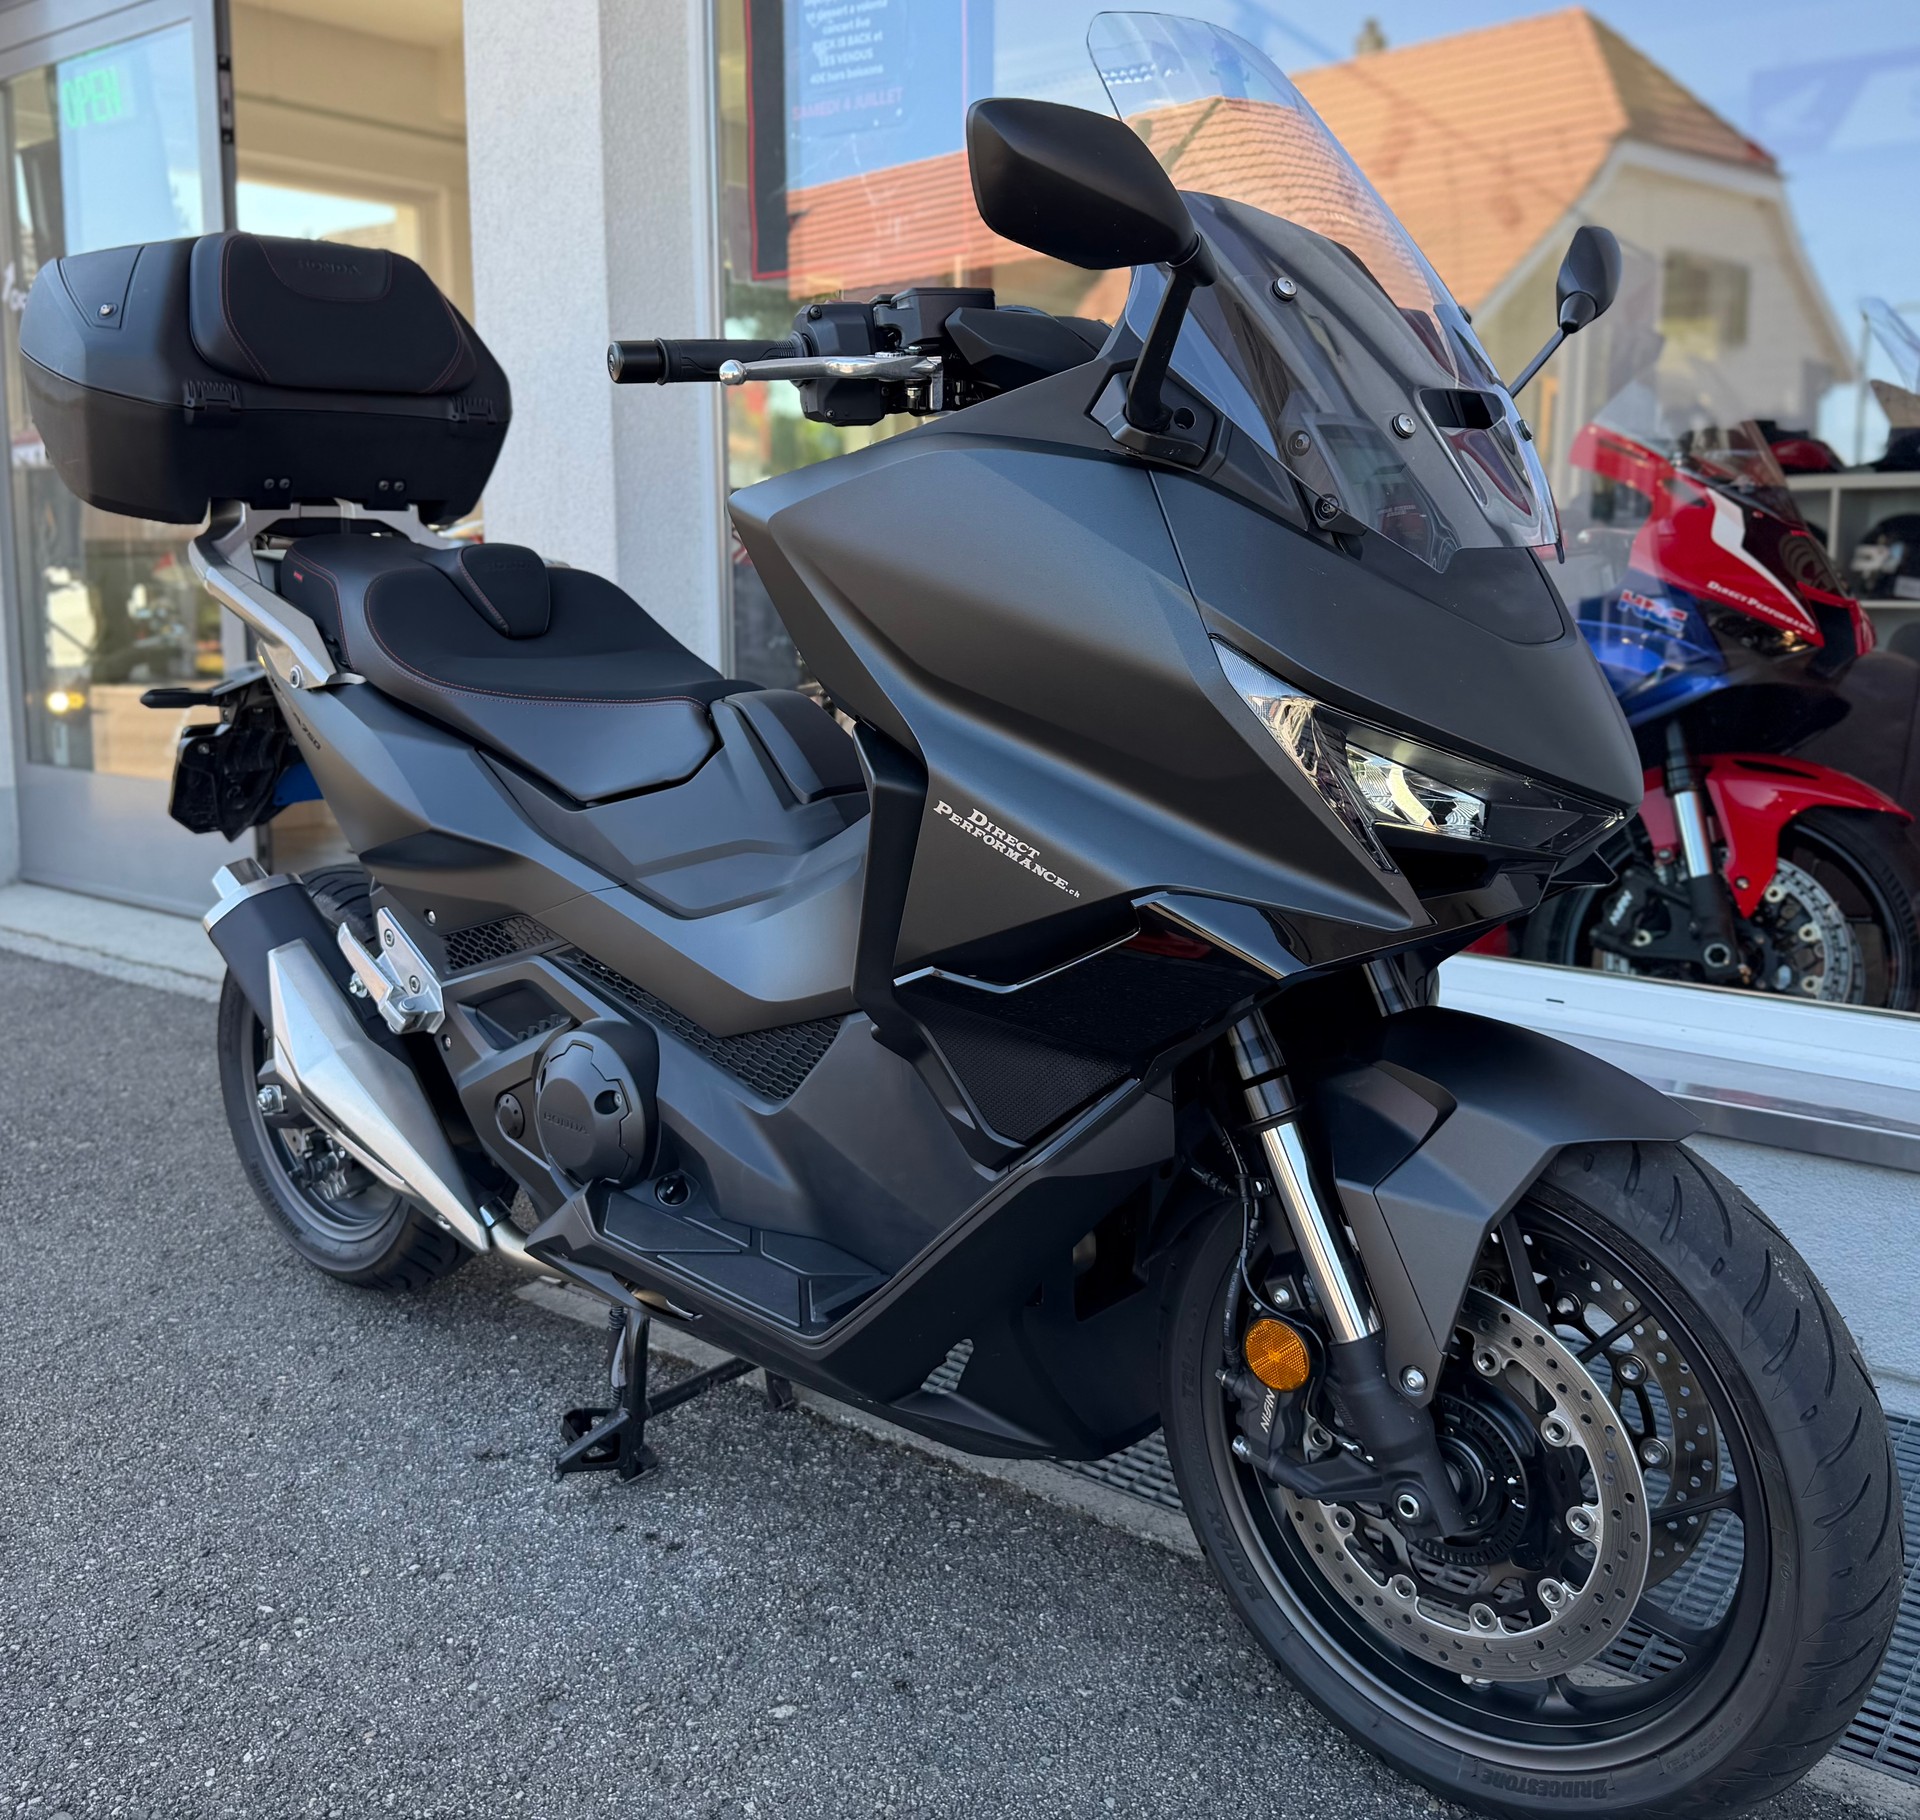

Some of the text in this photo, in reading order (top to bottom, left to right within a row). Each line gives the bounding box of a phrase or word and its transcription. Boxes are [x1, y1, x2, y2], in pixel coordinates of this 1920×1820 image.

[62, 66, 122, 129] OPEN
[792, 99, 840, 120] SAMEDI
[855, 87, 904, 109] JUILLET
[967, 808, 1040, 859] DIRECT
[543, 1110, 590, 1136] HONDA
[1480, 1769, 1608, 1799] BRIDGESTONE
